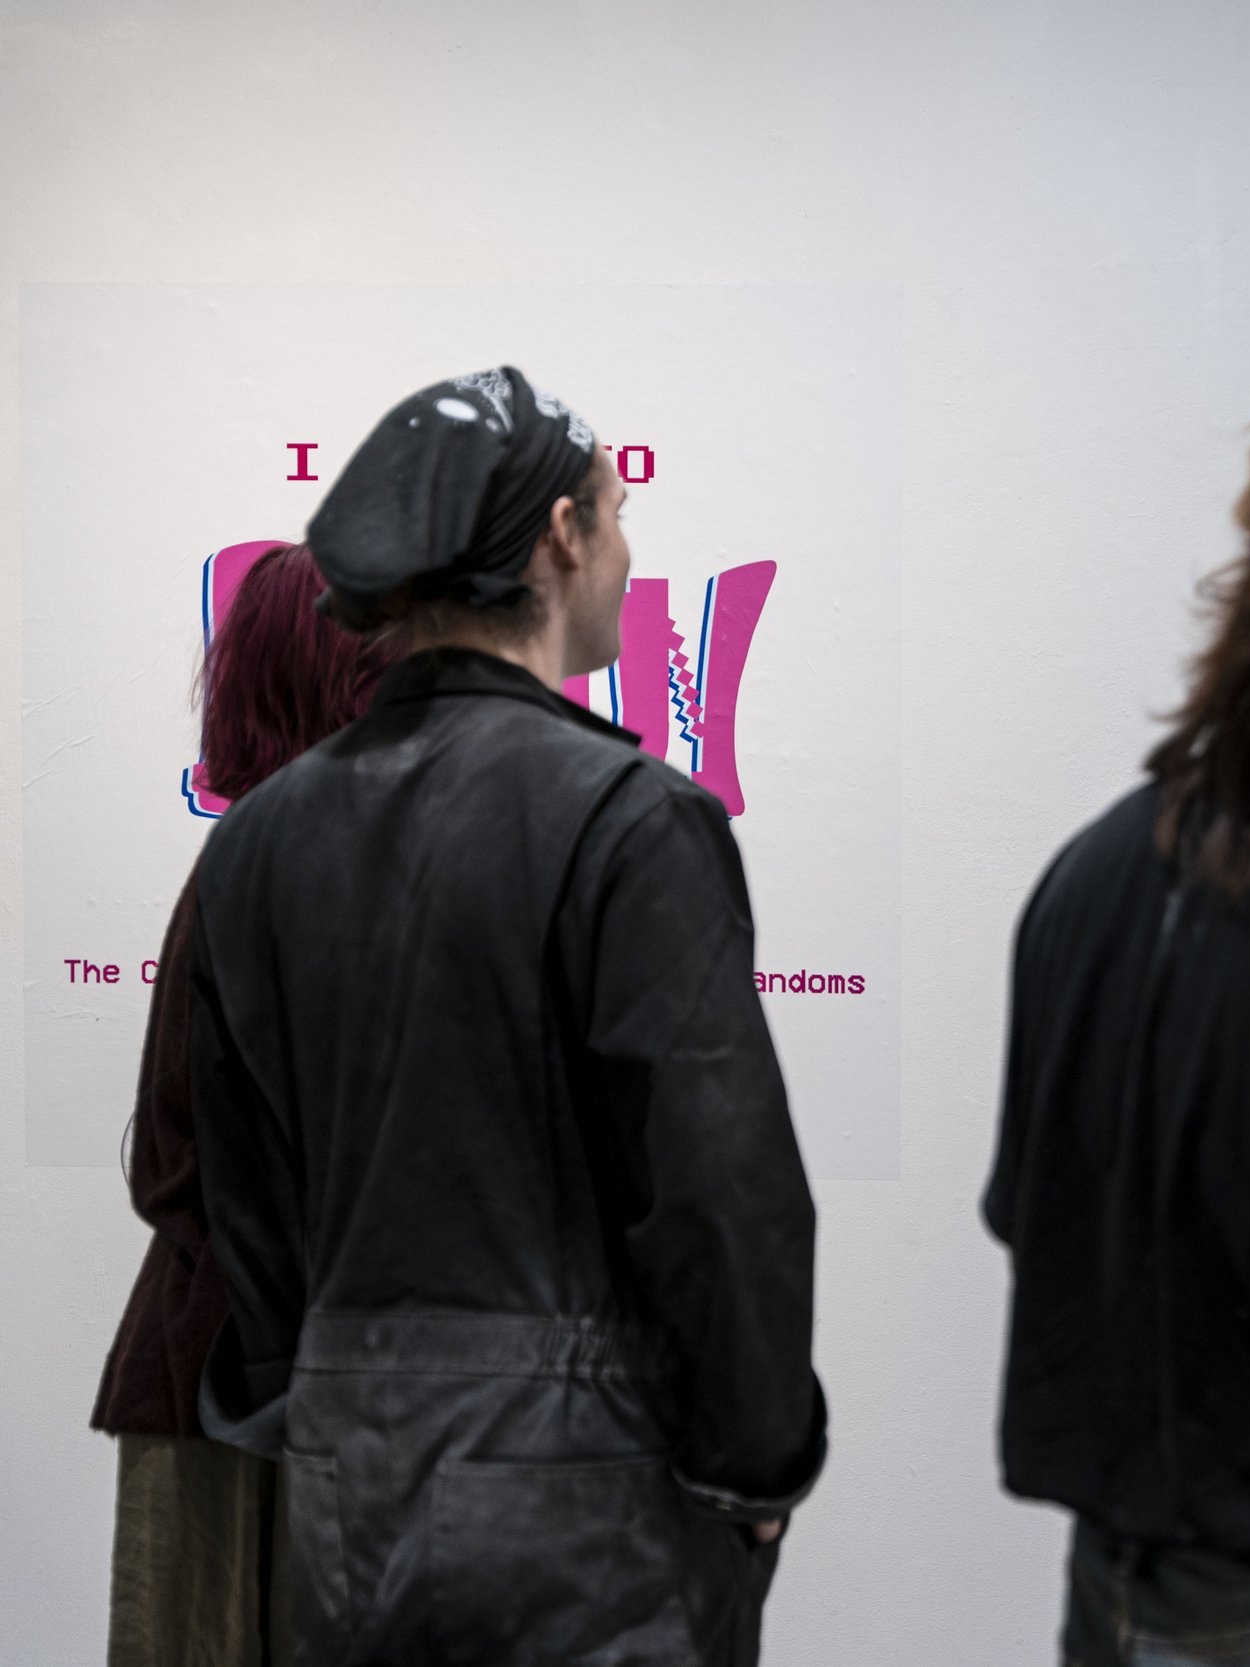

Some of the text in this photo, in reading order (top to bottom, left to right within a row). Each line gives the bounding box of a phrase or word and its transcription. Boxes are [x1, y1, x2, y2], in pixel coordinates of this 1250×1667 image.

[286, 443, 319, 481] I
[64, 959, 120, 983] The
[753, 969, 866, 995] andoms
